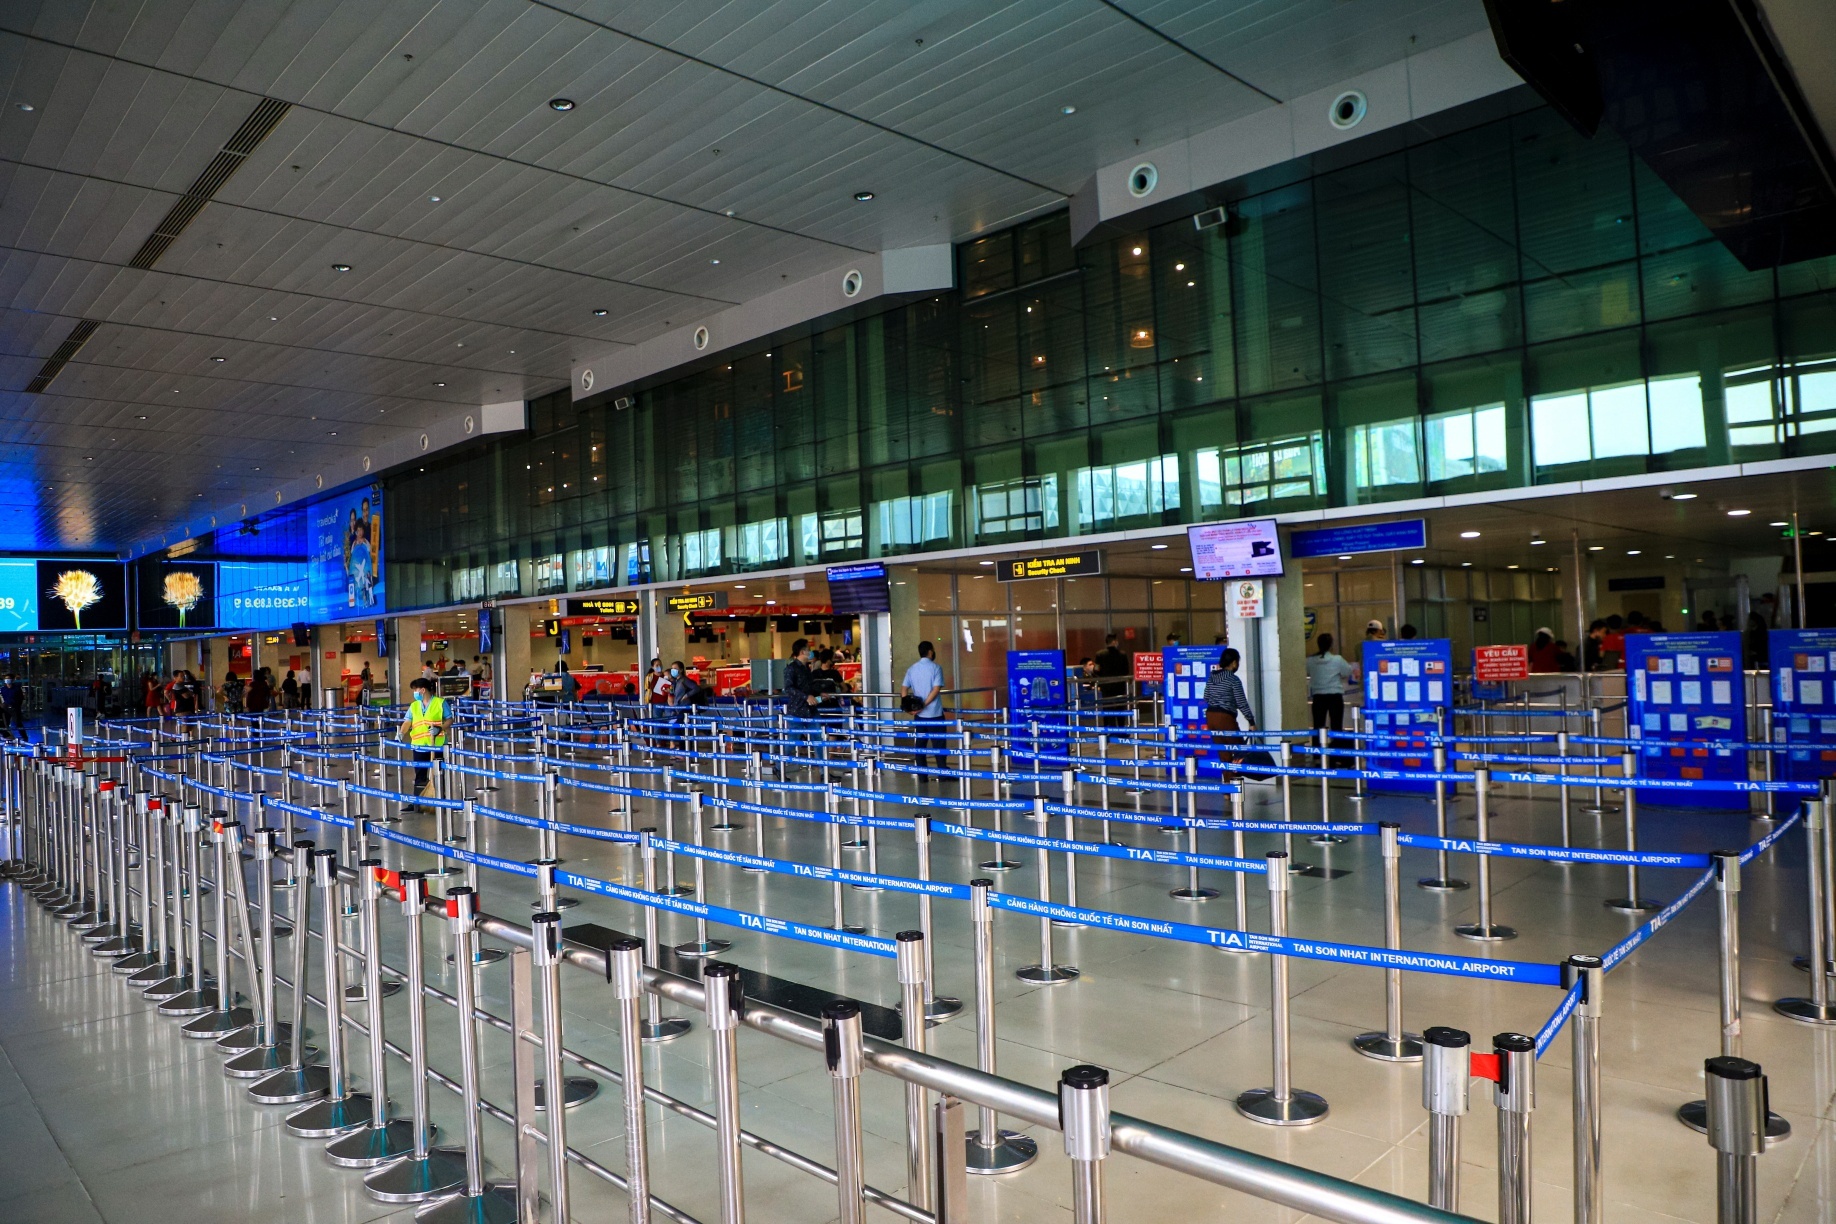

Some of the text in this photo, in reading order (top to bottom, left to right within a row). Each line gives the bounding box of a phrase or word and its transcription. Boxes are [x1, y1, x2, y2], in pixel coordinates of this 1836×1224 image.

[1028, 568, 1048, 576] Security
[550, 621, 558, 635] J
[1502, 648, 1518, 656] CẦU
[992, 772, 1006, 780] TIA
[1639, 778, 1647, 786] TẾ
[1734, 782, 1760, 790] TIA
[712, 798, 725, 807] TIA
[902, 796, 919, 804] TIA
[830, 815, 847, 824] TIA
[1146, 815, 1162, 823] NHẤT
[1182, 818, 1206, 827] TIA
[548, 822, 559, 830] TIA
[944, 824, 964, 835] TIA
[1279, 823, 1331, 831] INTERNATIONAL
[1332, 824, 1363, 832] AIRPORT
[650, 838, 664, 848] TIA
[988, 832, 1001, 840] CẢNG
[1017, 836, 1035, 844] KHÔNG
[1036, 838, 1051, 846] QUỐC
[1052, 839, 1059, 847] TẾ
[1060, 840, 1071, 848] TÂN
[1085, 843, 1099, 852] NHẤT
[1440, 840, 1471, 851] TIA
[452, 849, 464, 859] TIA
[696, 848, 707, 856] HÀNG
[724, 853, 735, 861] QUỐC
[736, 854, 742, 862] TẾ
[763, 859, 775, 868] NHẤT
[1127, 849, 1153, 860] TIA
[1512, 847, 1526, 855] TAN
[1548, 850, 1570, 858] NHAT
[1572, 852, 1640, 862] INTERNATIONAL
[1642, 855, 1681, 864] AIRPORT
[1200, 857, 1214, 865] SON
[1215, 858, 1233, 867] NHAT
[792, 865, 812, 876] TIA
[568, 874, 584, 888] TIA
[863, 875, 877, 883] NHAT
[879, 876, 924, 890] INTERNATIONAL
[926, 883, 952, 893] AIRPORT
[606, 886, 708, 915] CẢNG HÀNG KHÔNG QUỐC TẾ TÂN SƠN NHẤT
[739, 914, 762, 928] TIA
[1007, 900, 1173, 935] CẢNG HÀNG KHÔNG QUỐC TẾ TÂN SƠN NHẤT
[1650, 915, 1662, 932] TIA
[794, 927, 807, 935] TAN
[808, 929, 822, 938] SON
[823, 931, 842, 942] NHAT
[1206, 930, 1242, 946] TIA
[1249, 940, 1284, 948] INTERNATIONAL
[1293, 944, 1515, 976] TAN SON NHAT INTERNATIONAL AIRPORT
[1562, 992, 1576, 1017] AIRPORT
